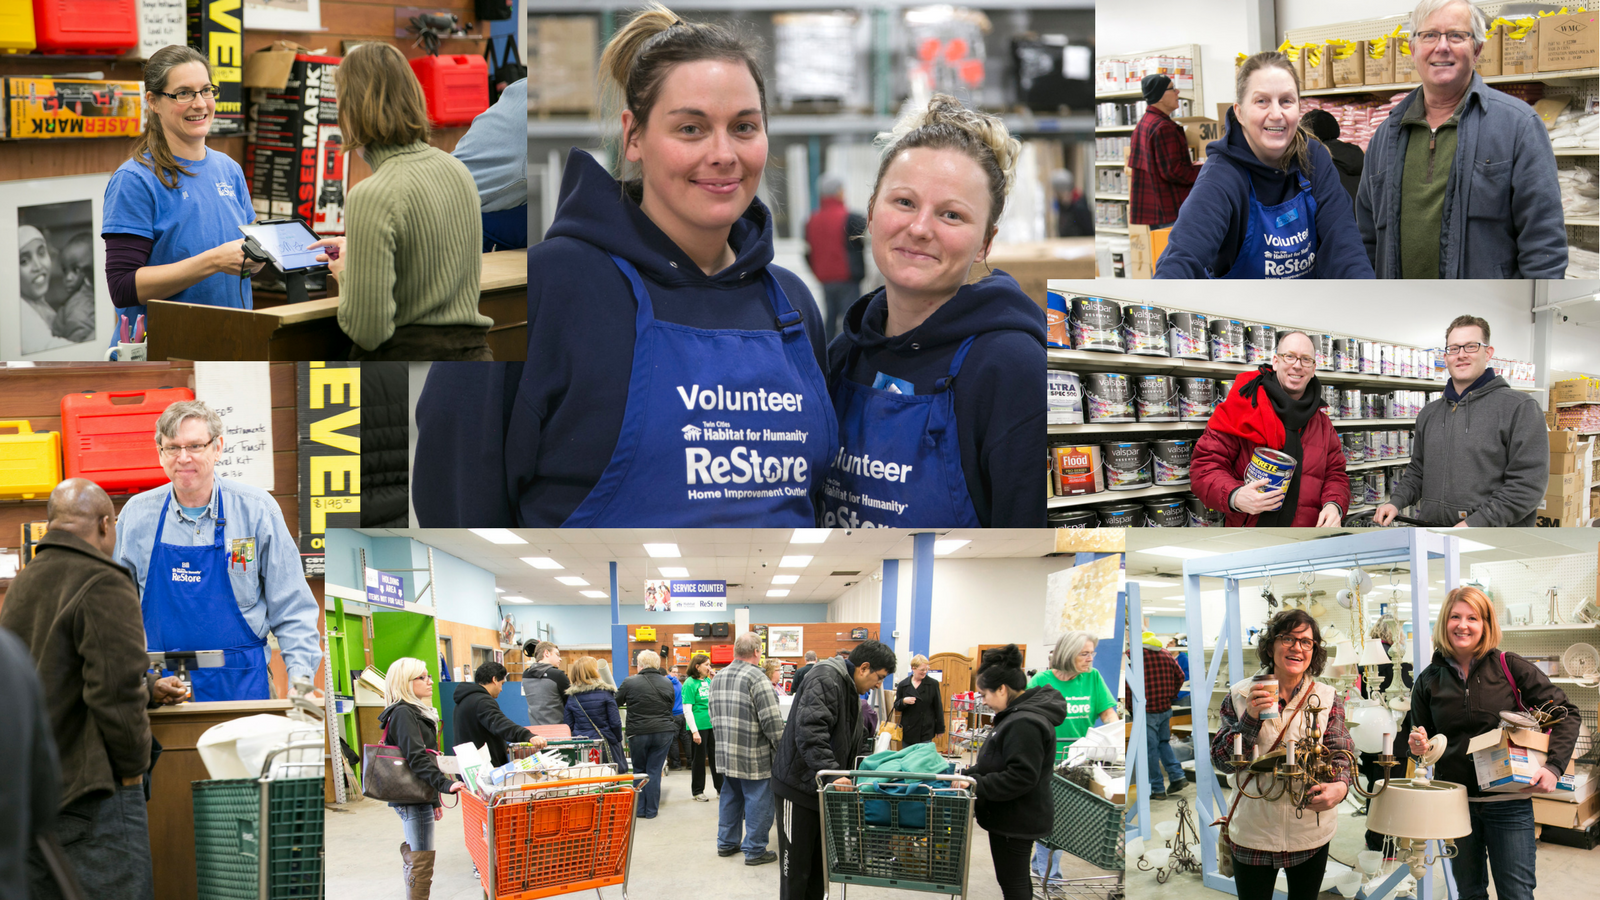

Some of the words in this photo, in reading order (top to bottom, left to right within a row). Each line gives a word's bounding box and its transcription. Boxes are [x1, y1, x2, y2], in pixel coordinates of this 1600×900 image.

[31, 118, 140, 133] LASERMARK
[1199, 123, 1218, 140] 3M
[298, 63, 321, 228] ASERMARK
[1265, 252, 1315, 276] ReStore
[1081, 302, 1112, 313] valspar
[1134, 310, 1161, 320] valspar
[1099, 379, 1127, 388] valspar
[677, 384, 803, 412] Volunteer
[704, 428, 744, 440] Habitat
[746, 429, 761, 440] for
[763, 429, 808, 443] Humanity
[238, 440, 266, 452] Transit
[310, 362, 360, 534] EVEL
[1168, 446, 1190, 455] valspar
[1112, 448, 1140, 458] valspar
[685, 446, 808, 484] ReStore
[1063, 455, 1088, 466] Flood
[688, 490, 721, 500] Home
[724, 488, 784, 499] Improvement
[785, 487, 807, 496] Outlet
[849, 491, 860, 504] for
[862, 494, 905, 515] Humanity
[1162, 508, 1184, 516] valspar
[1105, 515, 1133, 524] valspar
[1536, 516, 1560, 527] 3M
[172, 573, 201, 582] ReStore
[382, 575, 400, 586] HOLDING
[386, 585, 397, 594] AREA
[673, 584, 696, 592] SERVICE
[698, 584, 724, 592] COUNTER
[368, 593, 380, 601] ITEMS
[395, 598, 404, 606] SALE
[1067, 703, 1090, 714] tore
